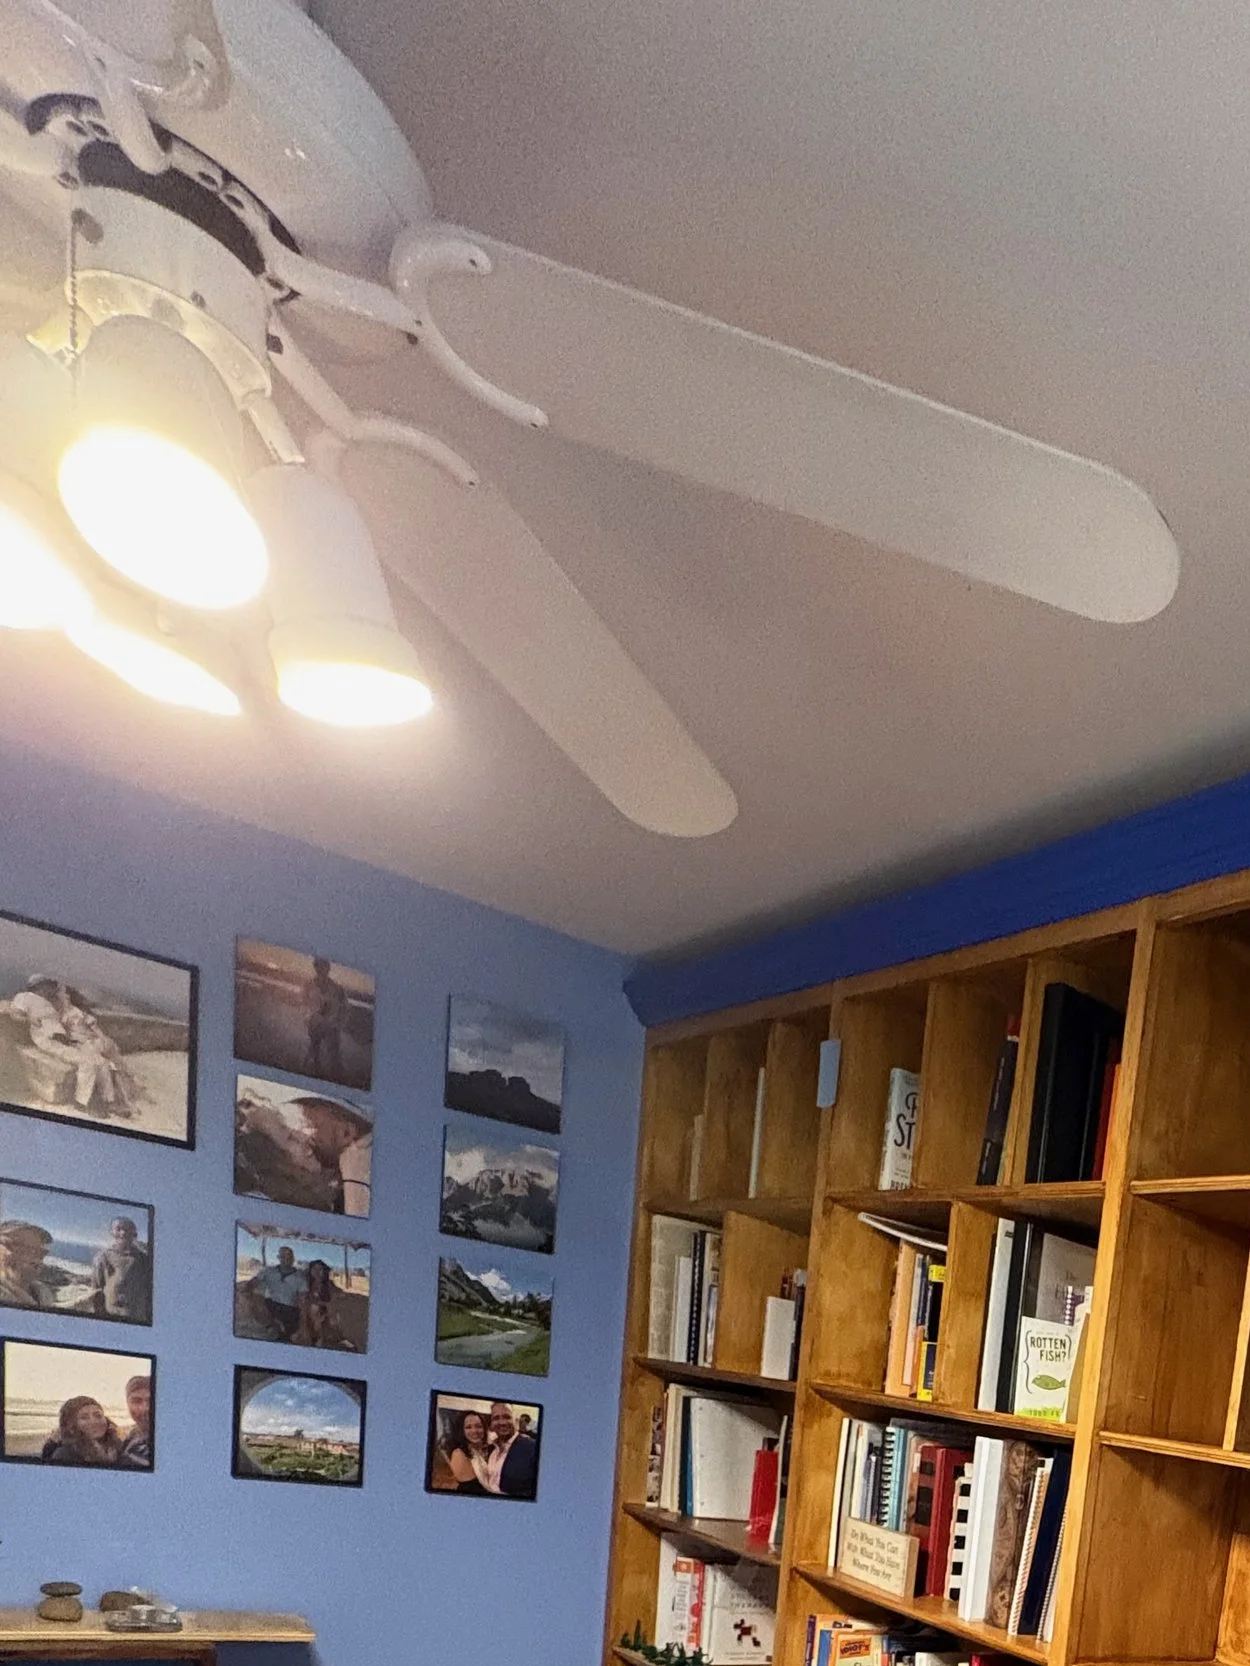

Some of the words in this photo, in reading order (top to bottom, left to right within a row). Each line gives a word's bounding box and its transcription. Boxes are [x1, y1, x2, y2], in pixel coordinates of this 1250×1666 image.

[1029, 1336, 1067, 1350] ROTTEN
[1039, 1350, 1067, 1363] FISH?
[860, 1532, 874, 1546] What
[876, 1537, 886, 1550] You
[886, 1542, 899, 1555] Can
[860, 1546, 874, 1560] What
[852, 1557, 869, 1572] Where
[870, 1565, 881, 1577] You
